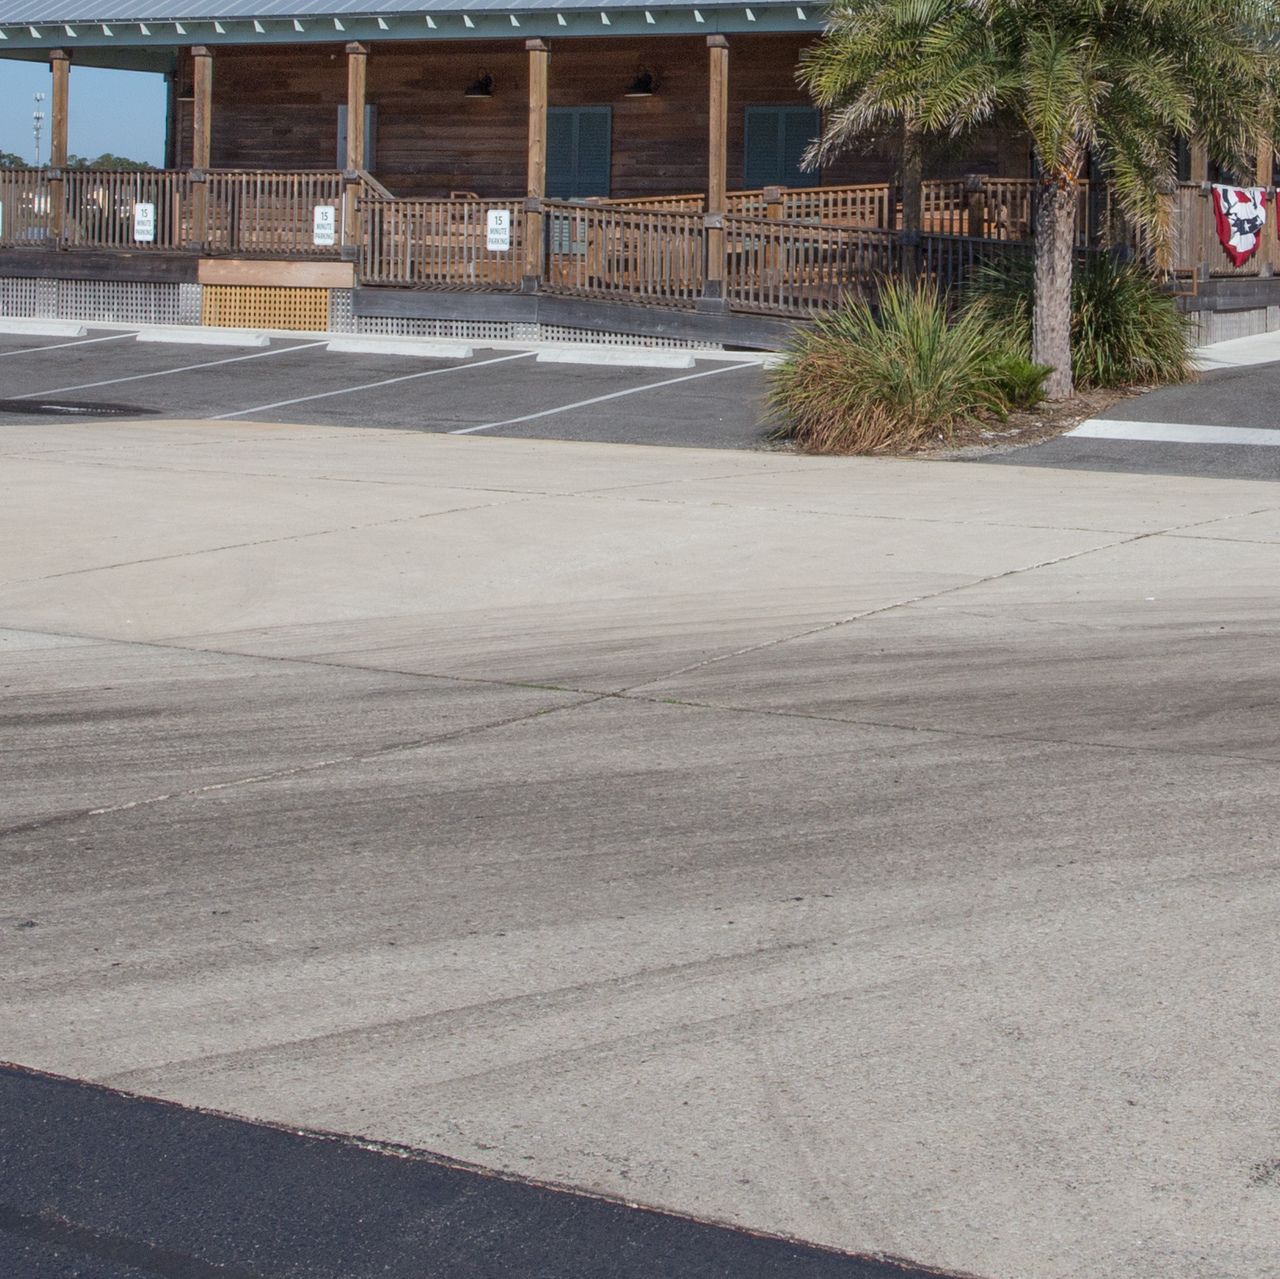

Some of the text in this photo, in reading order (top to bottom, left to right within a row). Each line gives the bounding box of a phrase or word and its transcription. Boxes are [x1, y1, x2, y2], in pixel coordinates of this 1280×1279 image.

[141, 209, 148, 218] 15
[321, 211, 329, 221] 15
[495, 215, 503, 225] 15
